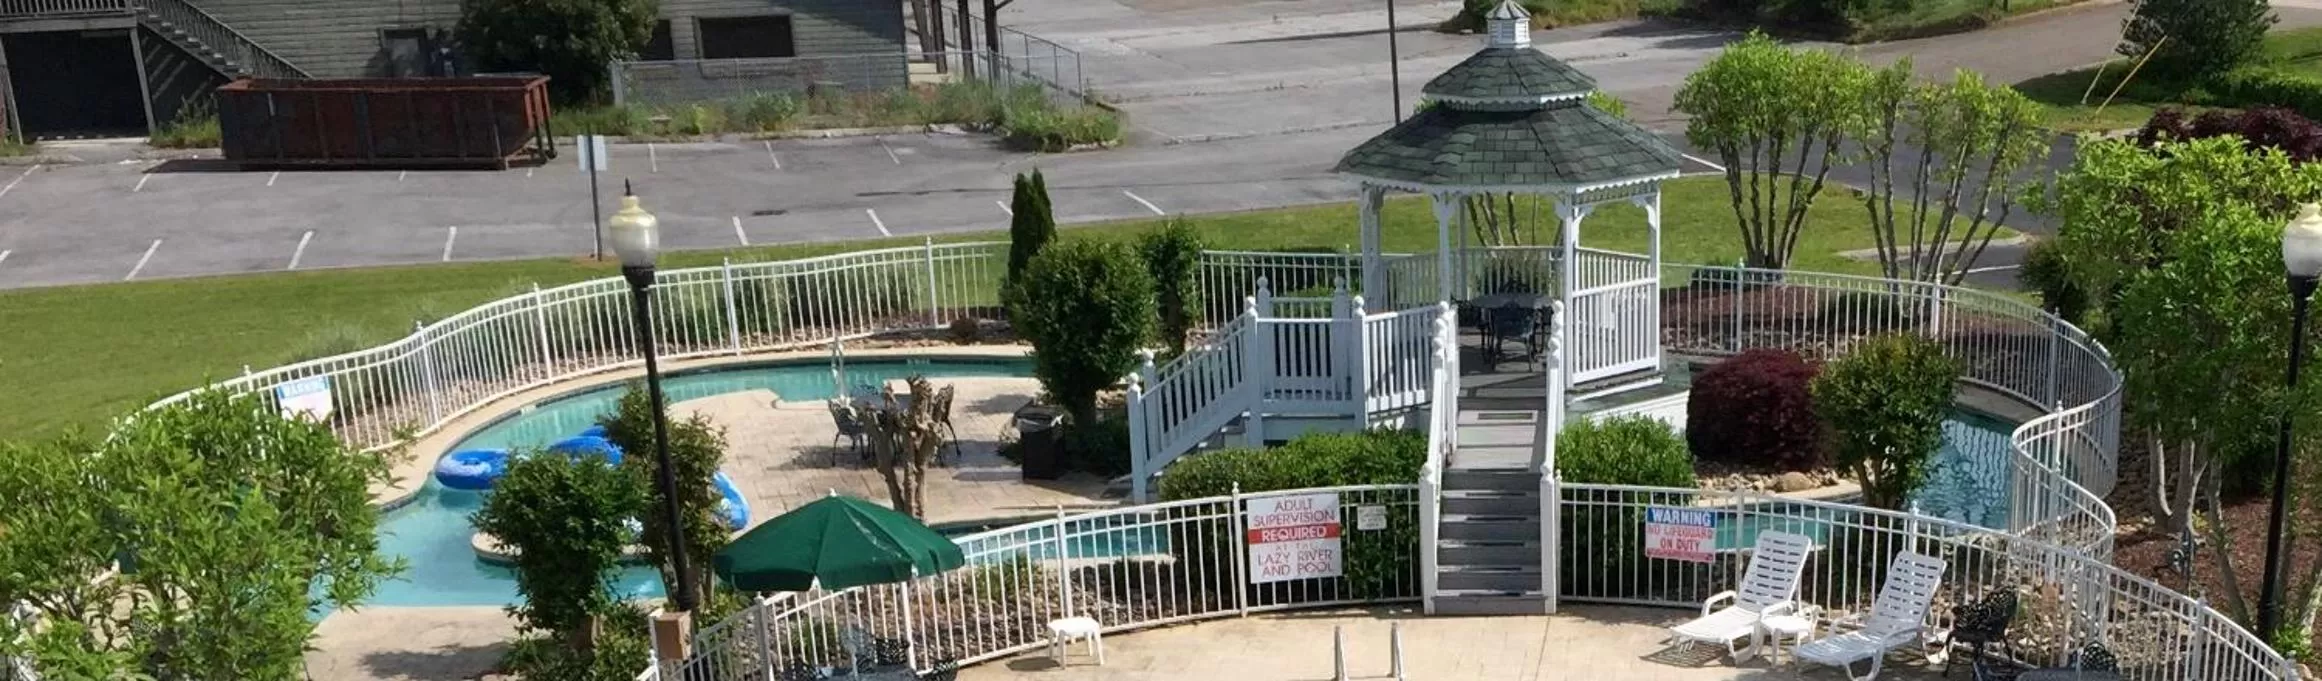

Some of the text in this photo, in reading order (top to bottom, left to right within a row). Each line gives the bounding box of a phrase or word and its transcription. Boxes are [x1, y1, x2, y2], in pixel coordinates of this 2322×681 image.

[1274, 499, 1312, 513] ADULT
[1254, 510, 1335, 527] SUPERVISION
[1652, 508, 1712, 527] WARNING
[1261, 526, 1327, 542] REQUIRED
[1648, 525, 1660, 535] NO
[1660, 538, 1701, 552] ON DUTY
[1258, 550, 1333, 566] LAZY RIVER
[1262, 562, 1333, 577] AND POOL
